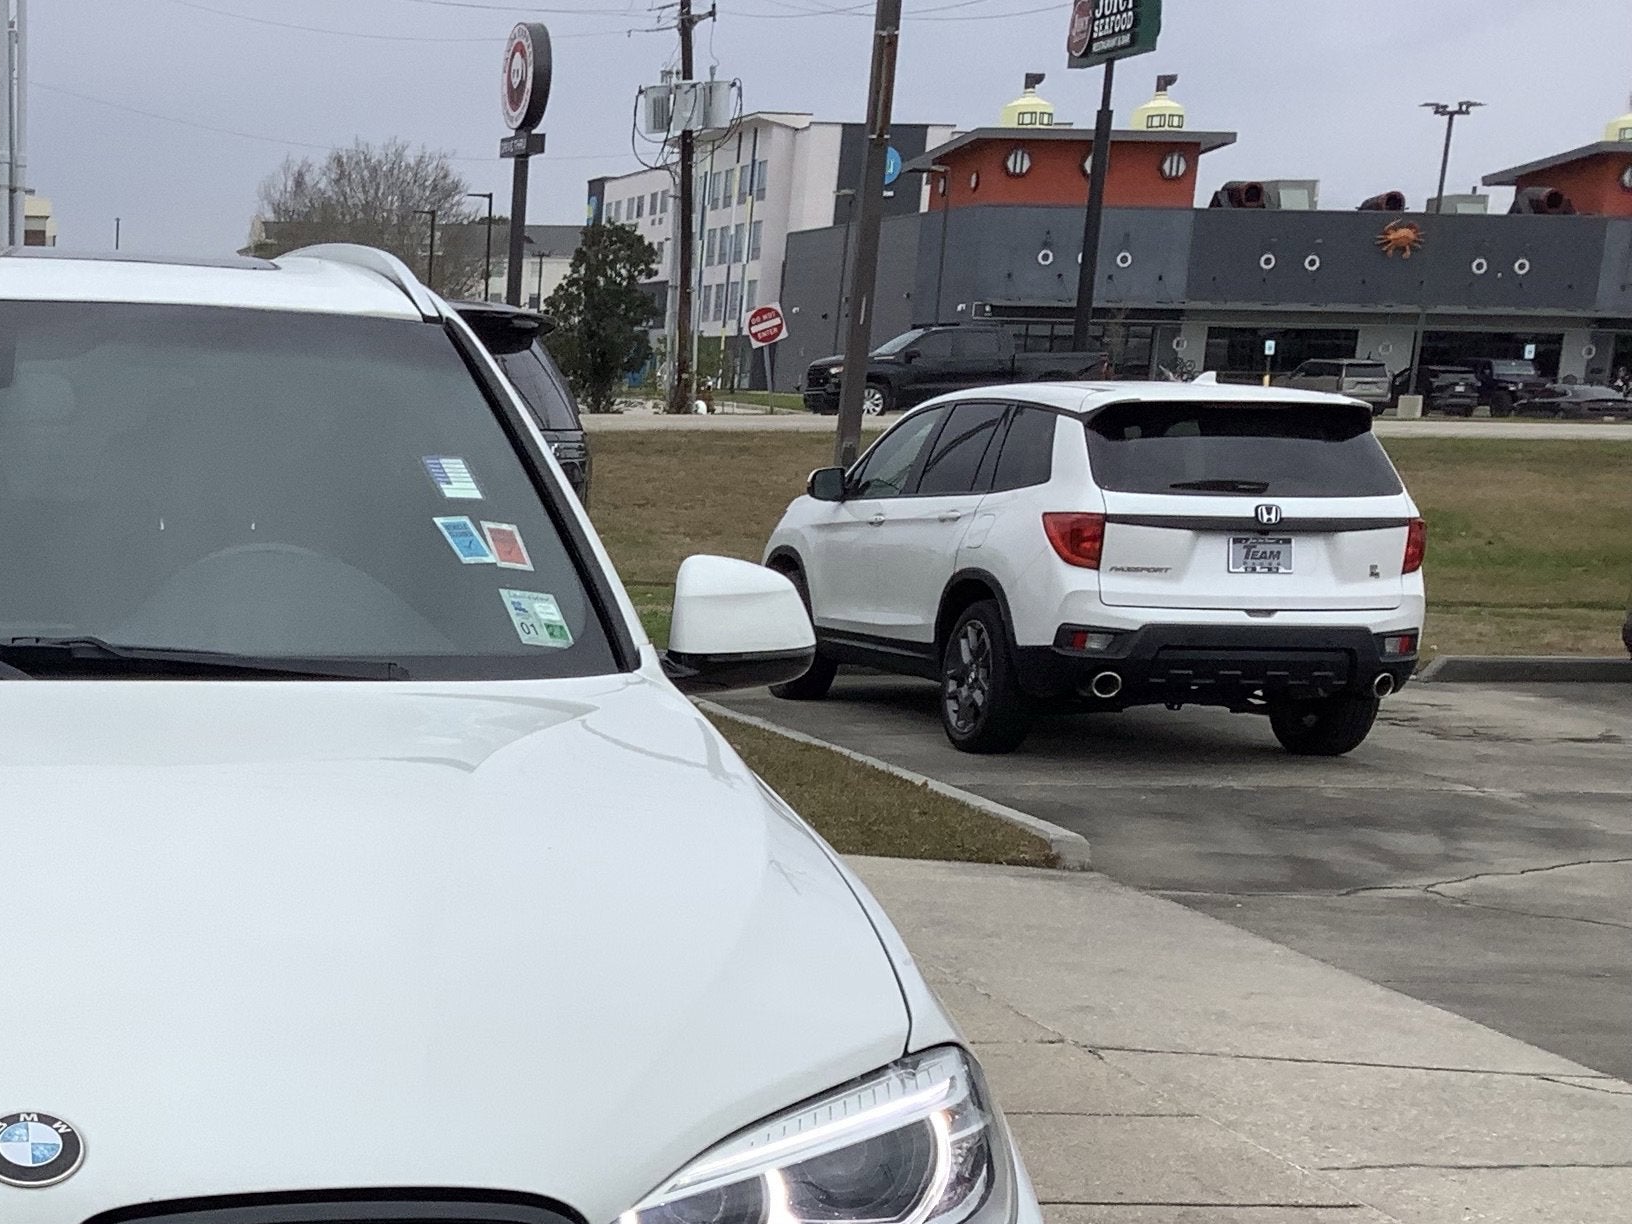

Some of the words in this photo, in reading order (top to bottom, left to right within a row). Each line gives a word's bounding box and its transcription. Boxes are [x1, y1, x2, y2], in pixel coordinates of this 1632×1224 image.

[1093, 11, 1134, 38] SEAFOOD
[751, 315, 761, 325] DO
[757, 327, 778, 340] ENTER
[519, 621, 539, 637] 01
